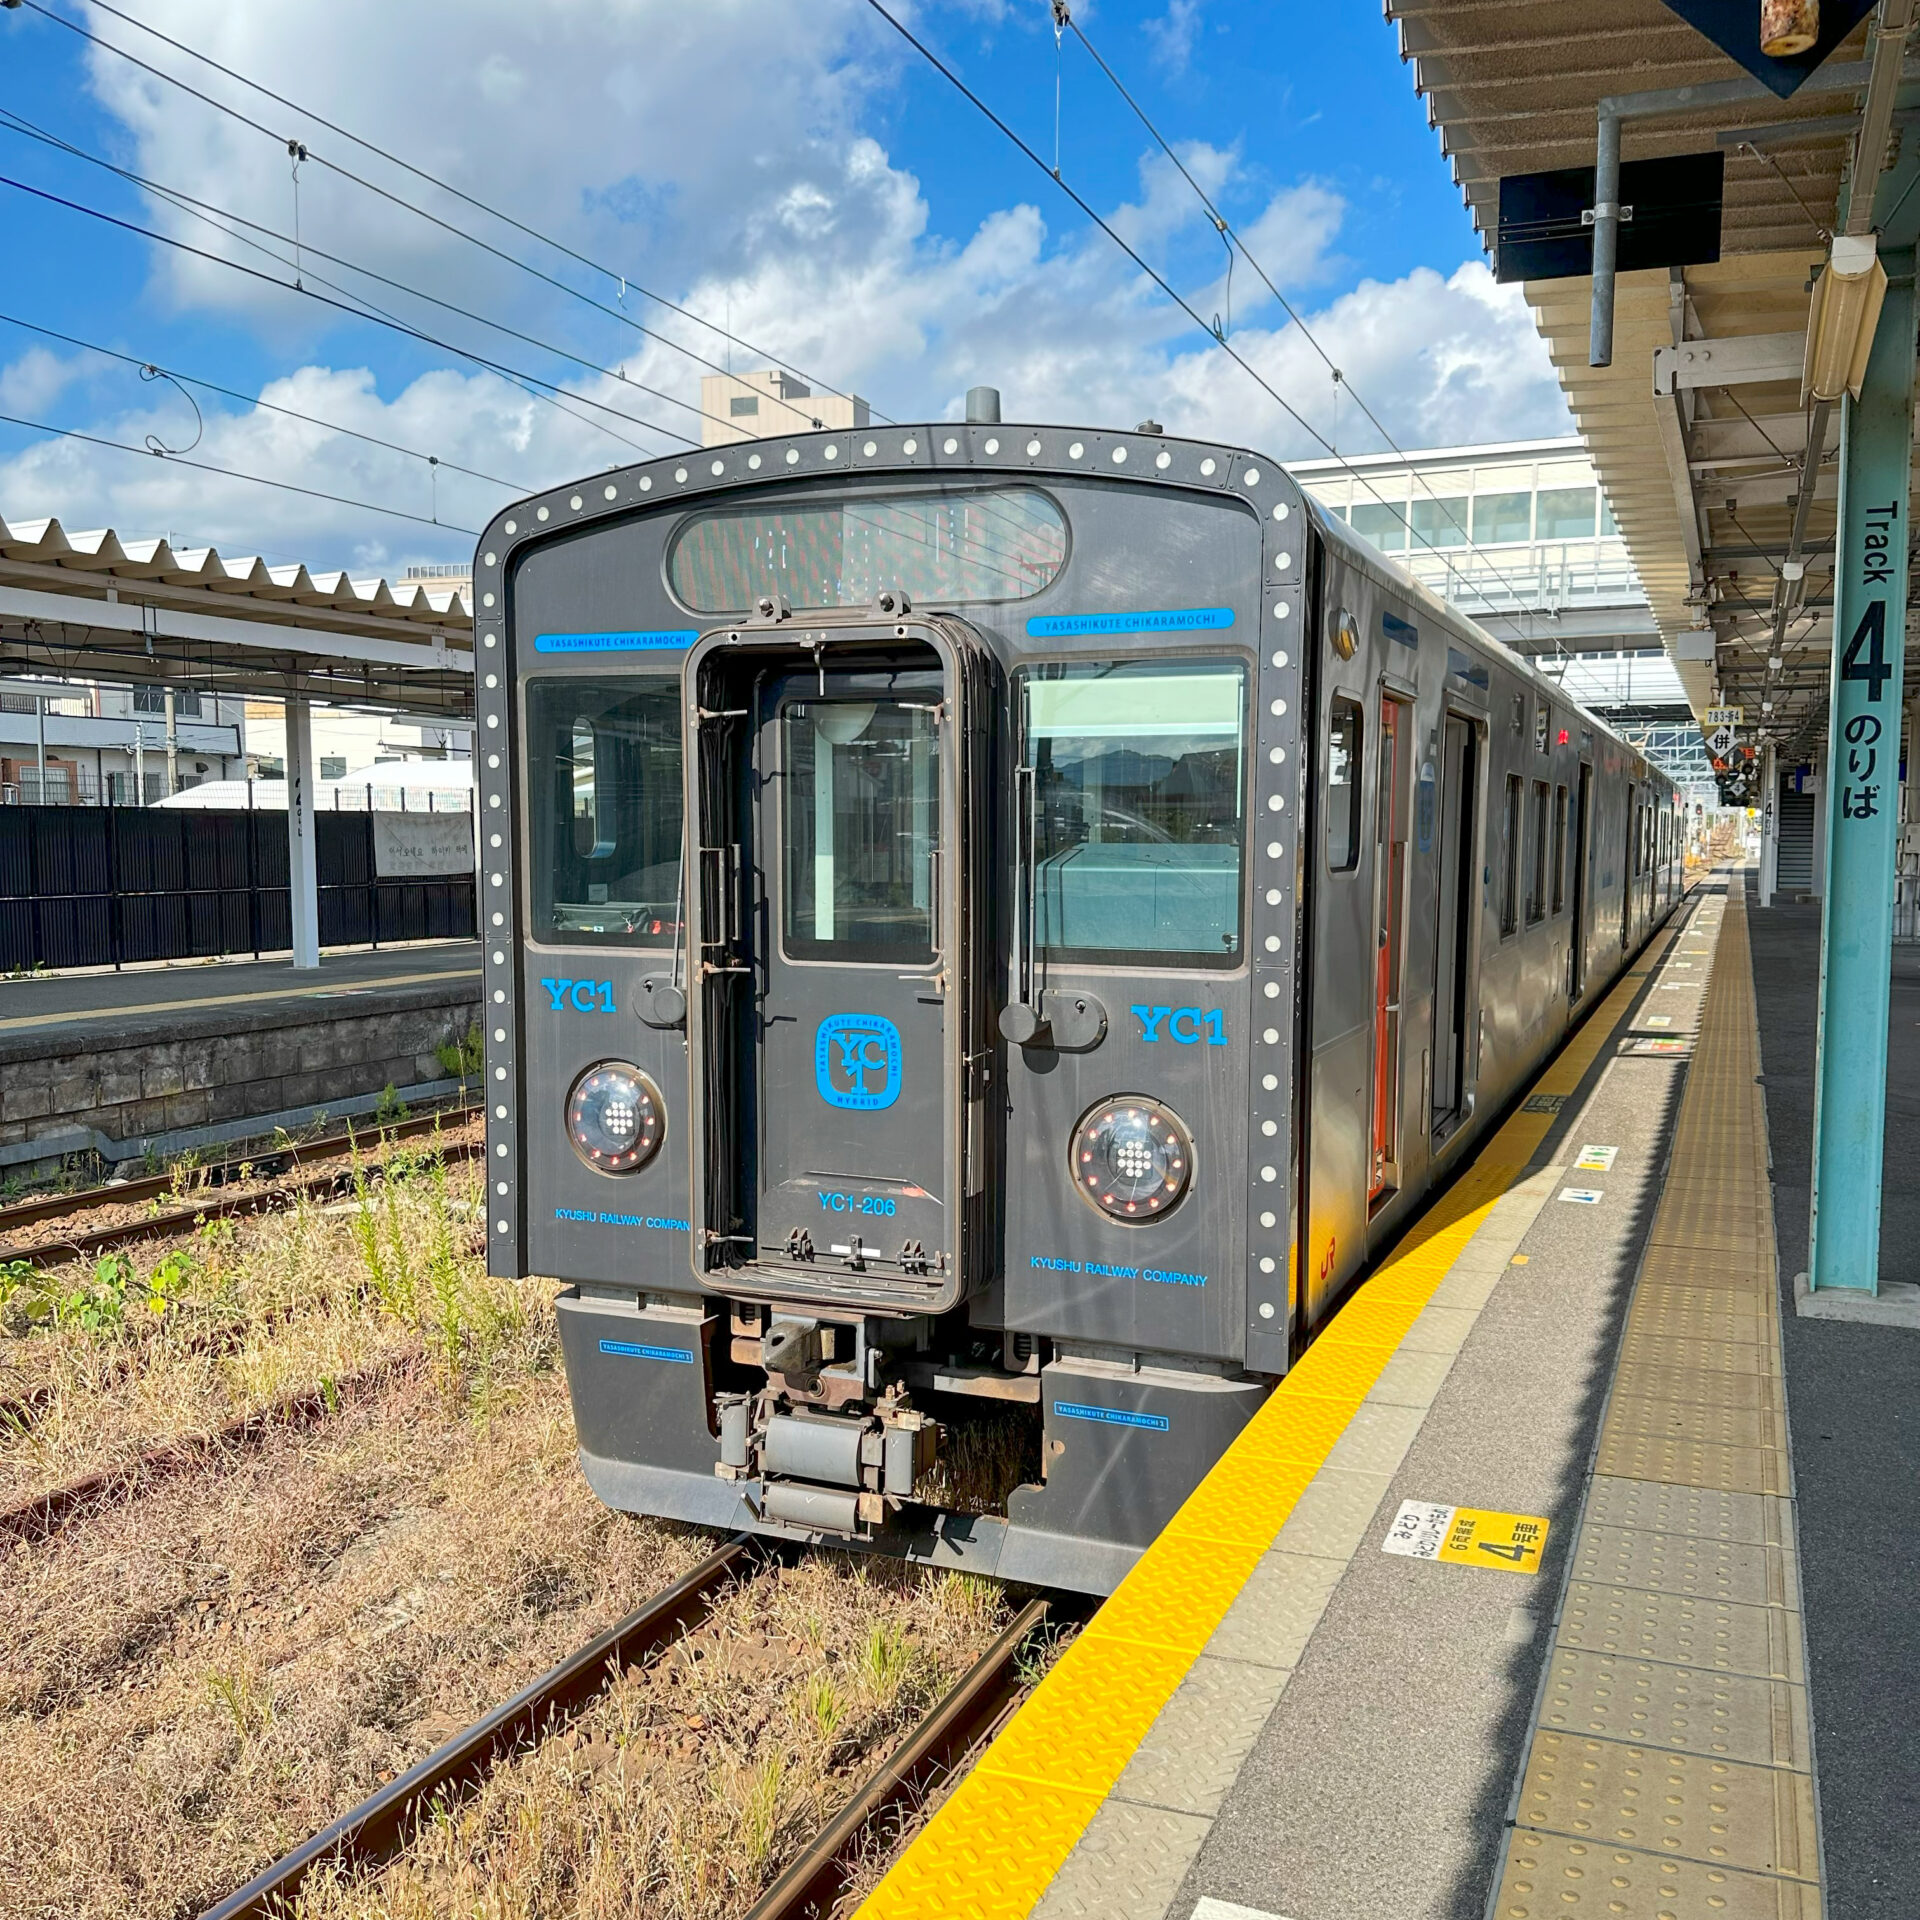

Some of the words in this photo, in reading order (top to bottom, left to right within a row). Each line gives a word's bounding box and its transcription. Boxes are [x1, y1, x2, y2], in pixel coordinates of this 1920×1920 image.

[1863, 500, 1898, 586] Track
[1044, 616, 1121, 632] YASASHIKUTE
[1124, 613, 1216, 629] CHIKARAMOCHI
[550, 637, 611, 648] YASASHIKUTE
[613, 635, 686, 647] CHIKARAMOCHI
[1713, 734, 1731, 750] 併
[541, 978, 617, 1013] YC1
[1130, 1004, 1228, 1046] YC1
[837, 1097, 879, 1106] HYBRID
[817, 1191, 897, 1217] YC1-206
[555, 1208, 597, 1223] KYUSHU
[599, 1212, 644, 1228] RAILWAY
[646, 1216, 691, 1232] COMPAN
[1030, 1255, 1082, 1273] KYUSHU
[1085, 1262, 1139, 1280] RAILWAY
[1142, 1269, 1209, 1287] COMPANY
[1320, 1236, 1336, 1281] JR
[1059, 1405, 1105, 1419] YASASHIKUTE
[1106, 1412, 1159, 1427] CHIKARAMOCHI
[1393, 1514, 1421, 1540] みどり
[1478, 1522, 1541, 1562] 4号車
